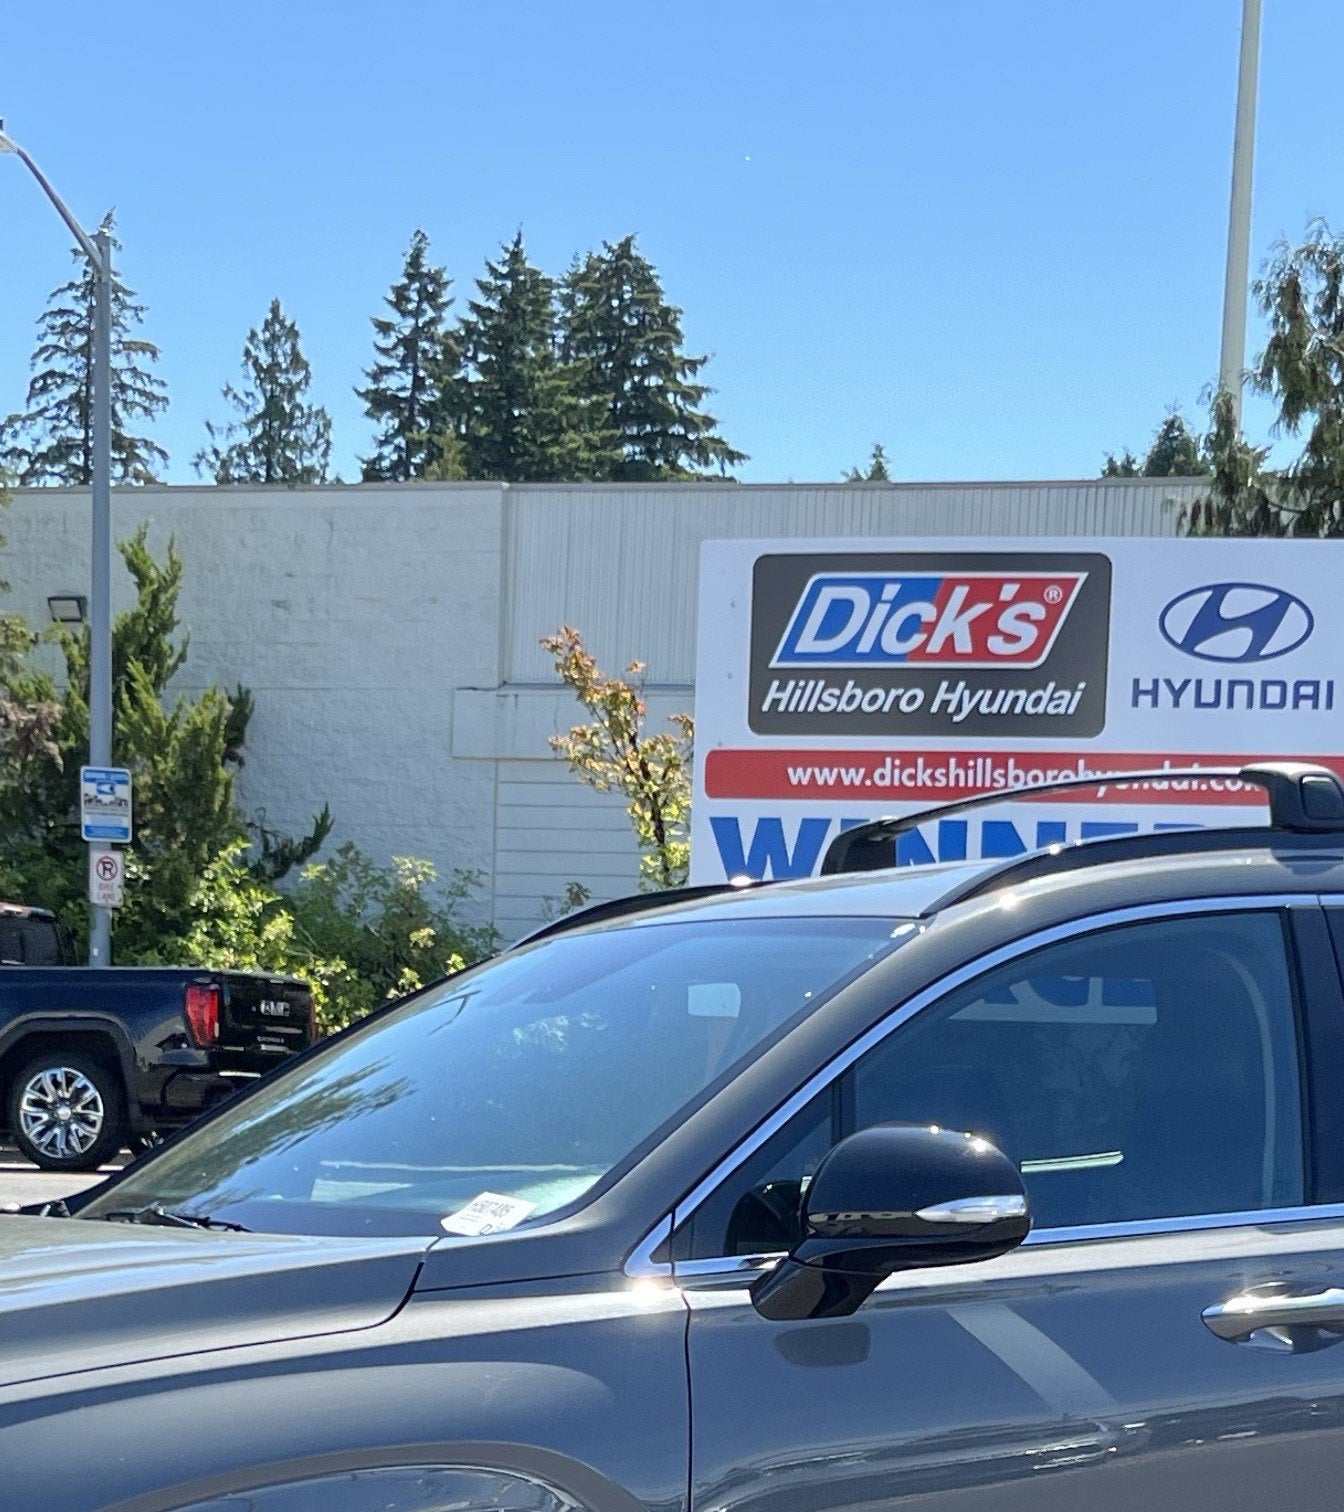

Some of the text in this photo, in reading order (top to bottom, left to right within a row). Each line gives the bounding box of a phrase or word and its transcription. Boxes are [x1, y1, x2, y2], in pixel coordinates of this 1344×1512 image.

[762, 679, 1086, 723] Hillsboro Hyundai
[1132, 678, 1335, 711] HYUNDAI
